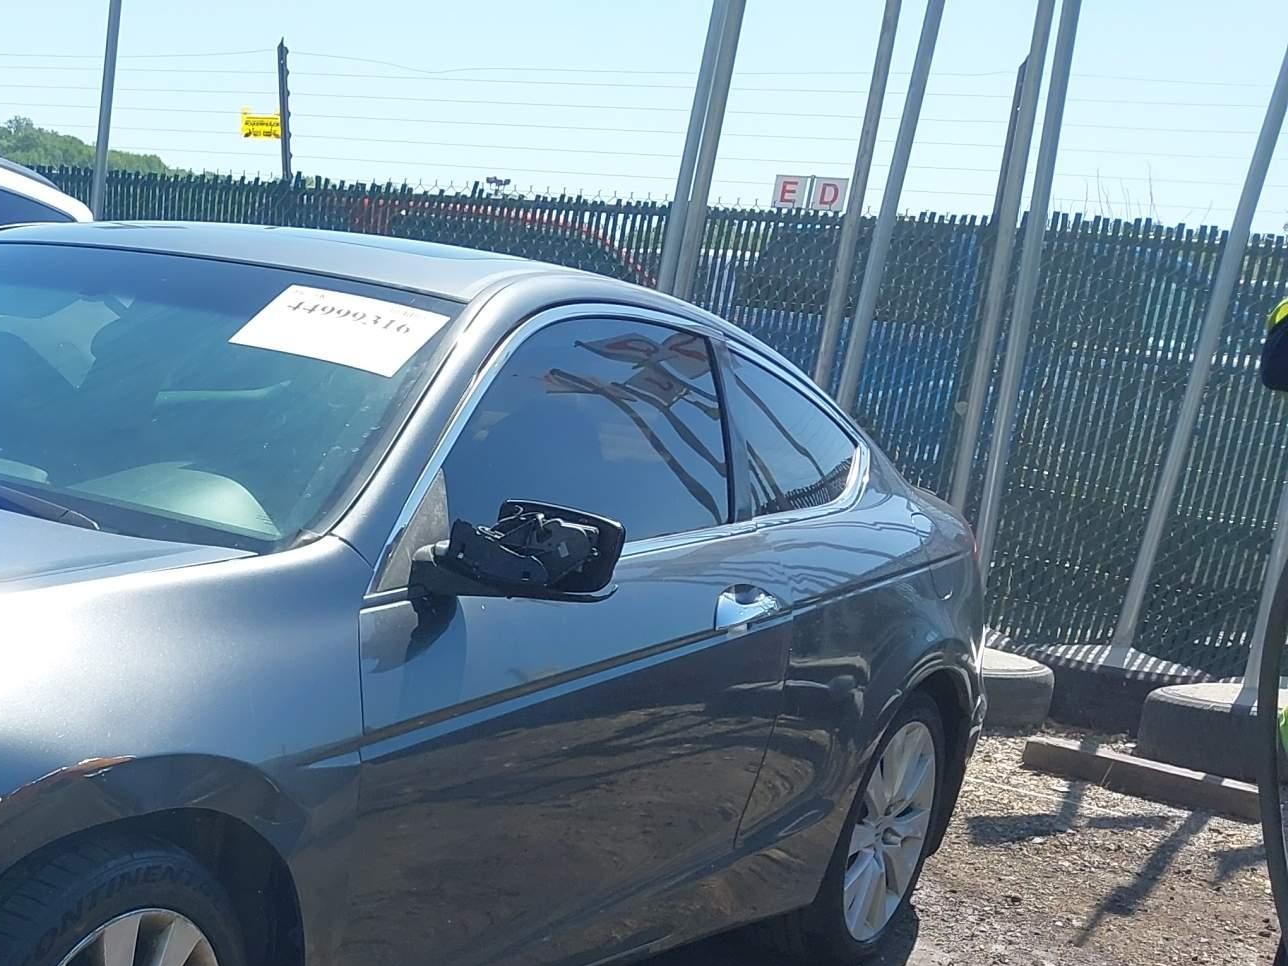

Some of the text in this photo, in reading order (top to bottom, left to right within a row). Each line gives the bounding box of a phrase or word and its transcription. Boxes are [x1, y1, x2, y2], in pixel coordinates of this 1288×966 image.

[779, 181, 799, 203] E
[819, 183, 839, 205] D
[287, 300, 411, 335] 44999316
